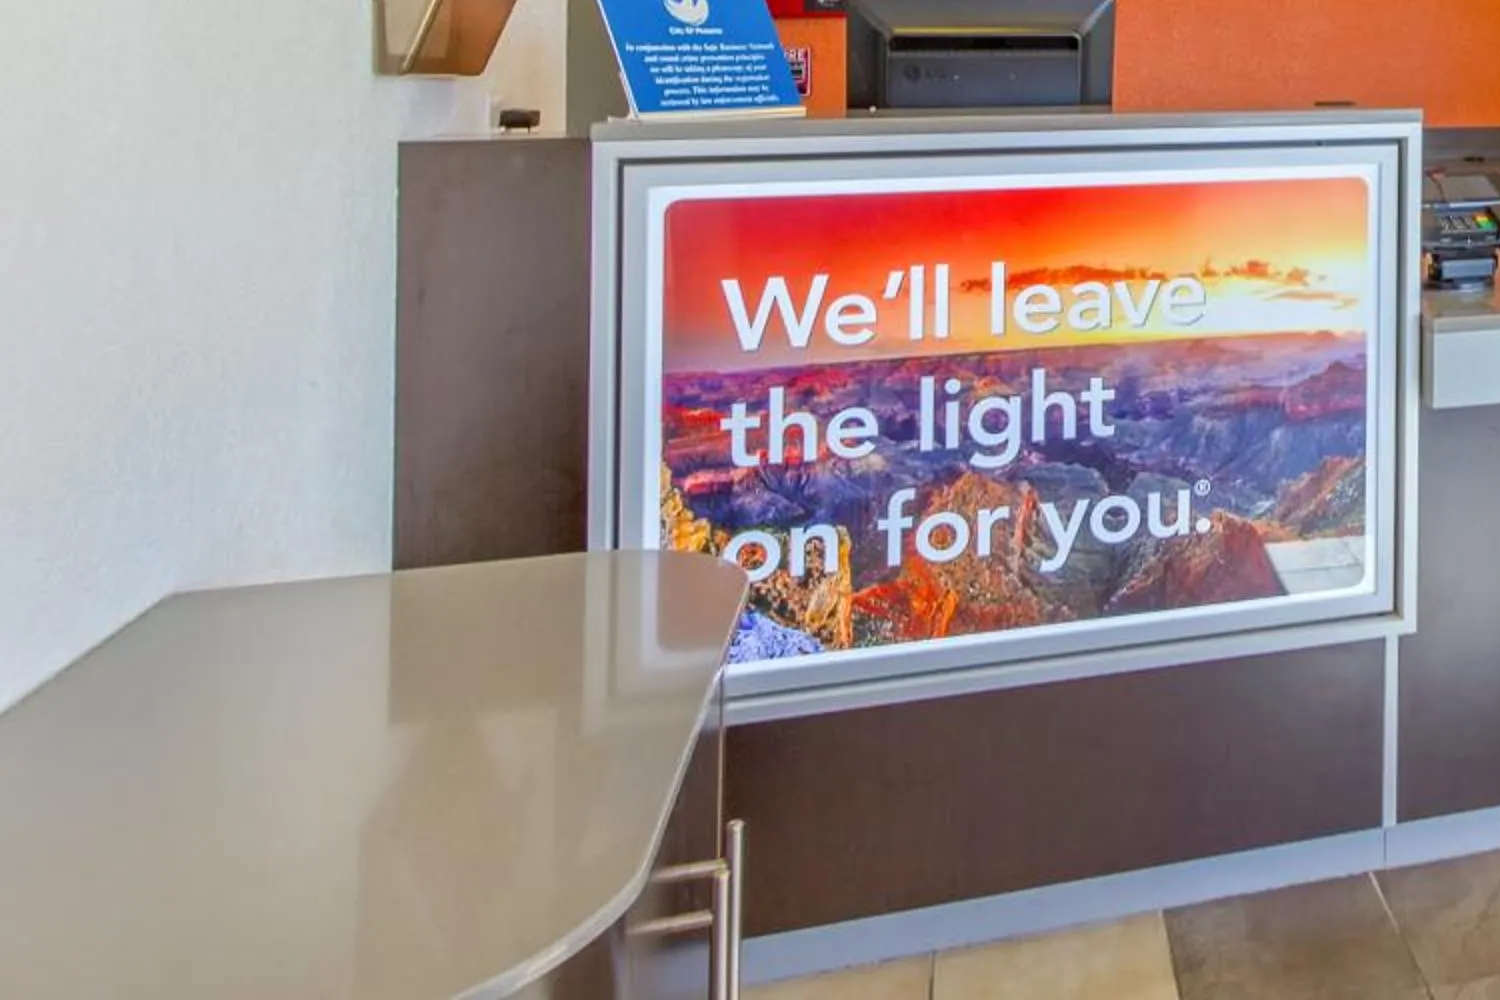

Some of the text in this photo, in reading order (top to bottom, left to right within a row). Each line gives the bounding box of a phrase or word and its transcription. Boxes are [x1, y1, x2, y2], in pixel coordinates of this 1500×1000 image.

[721, 261, 1207, 352] We'll leave
[721, 368, 1116, 468] the light
[723, 524, 839, 582] on
[878, 488, 1012, 567] for
